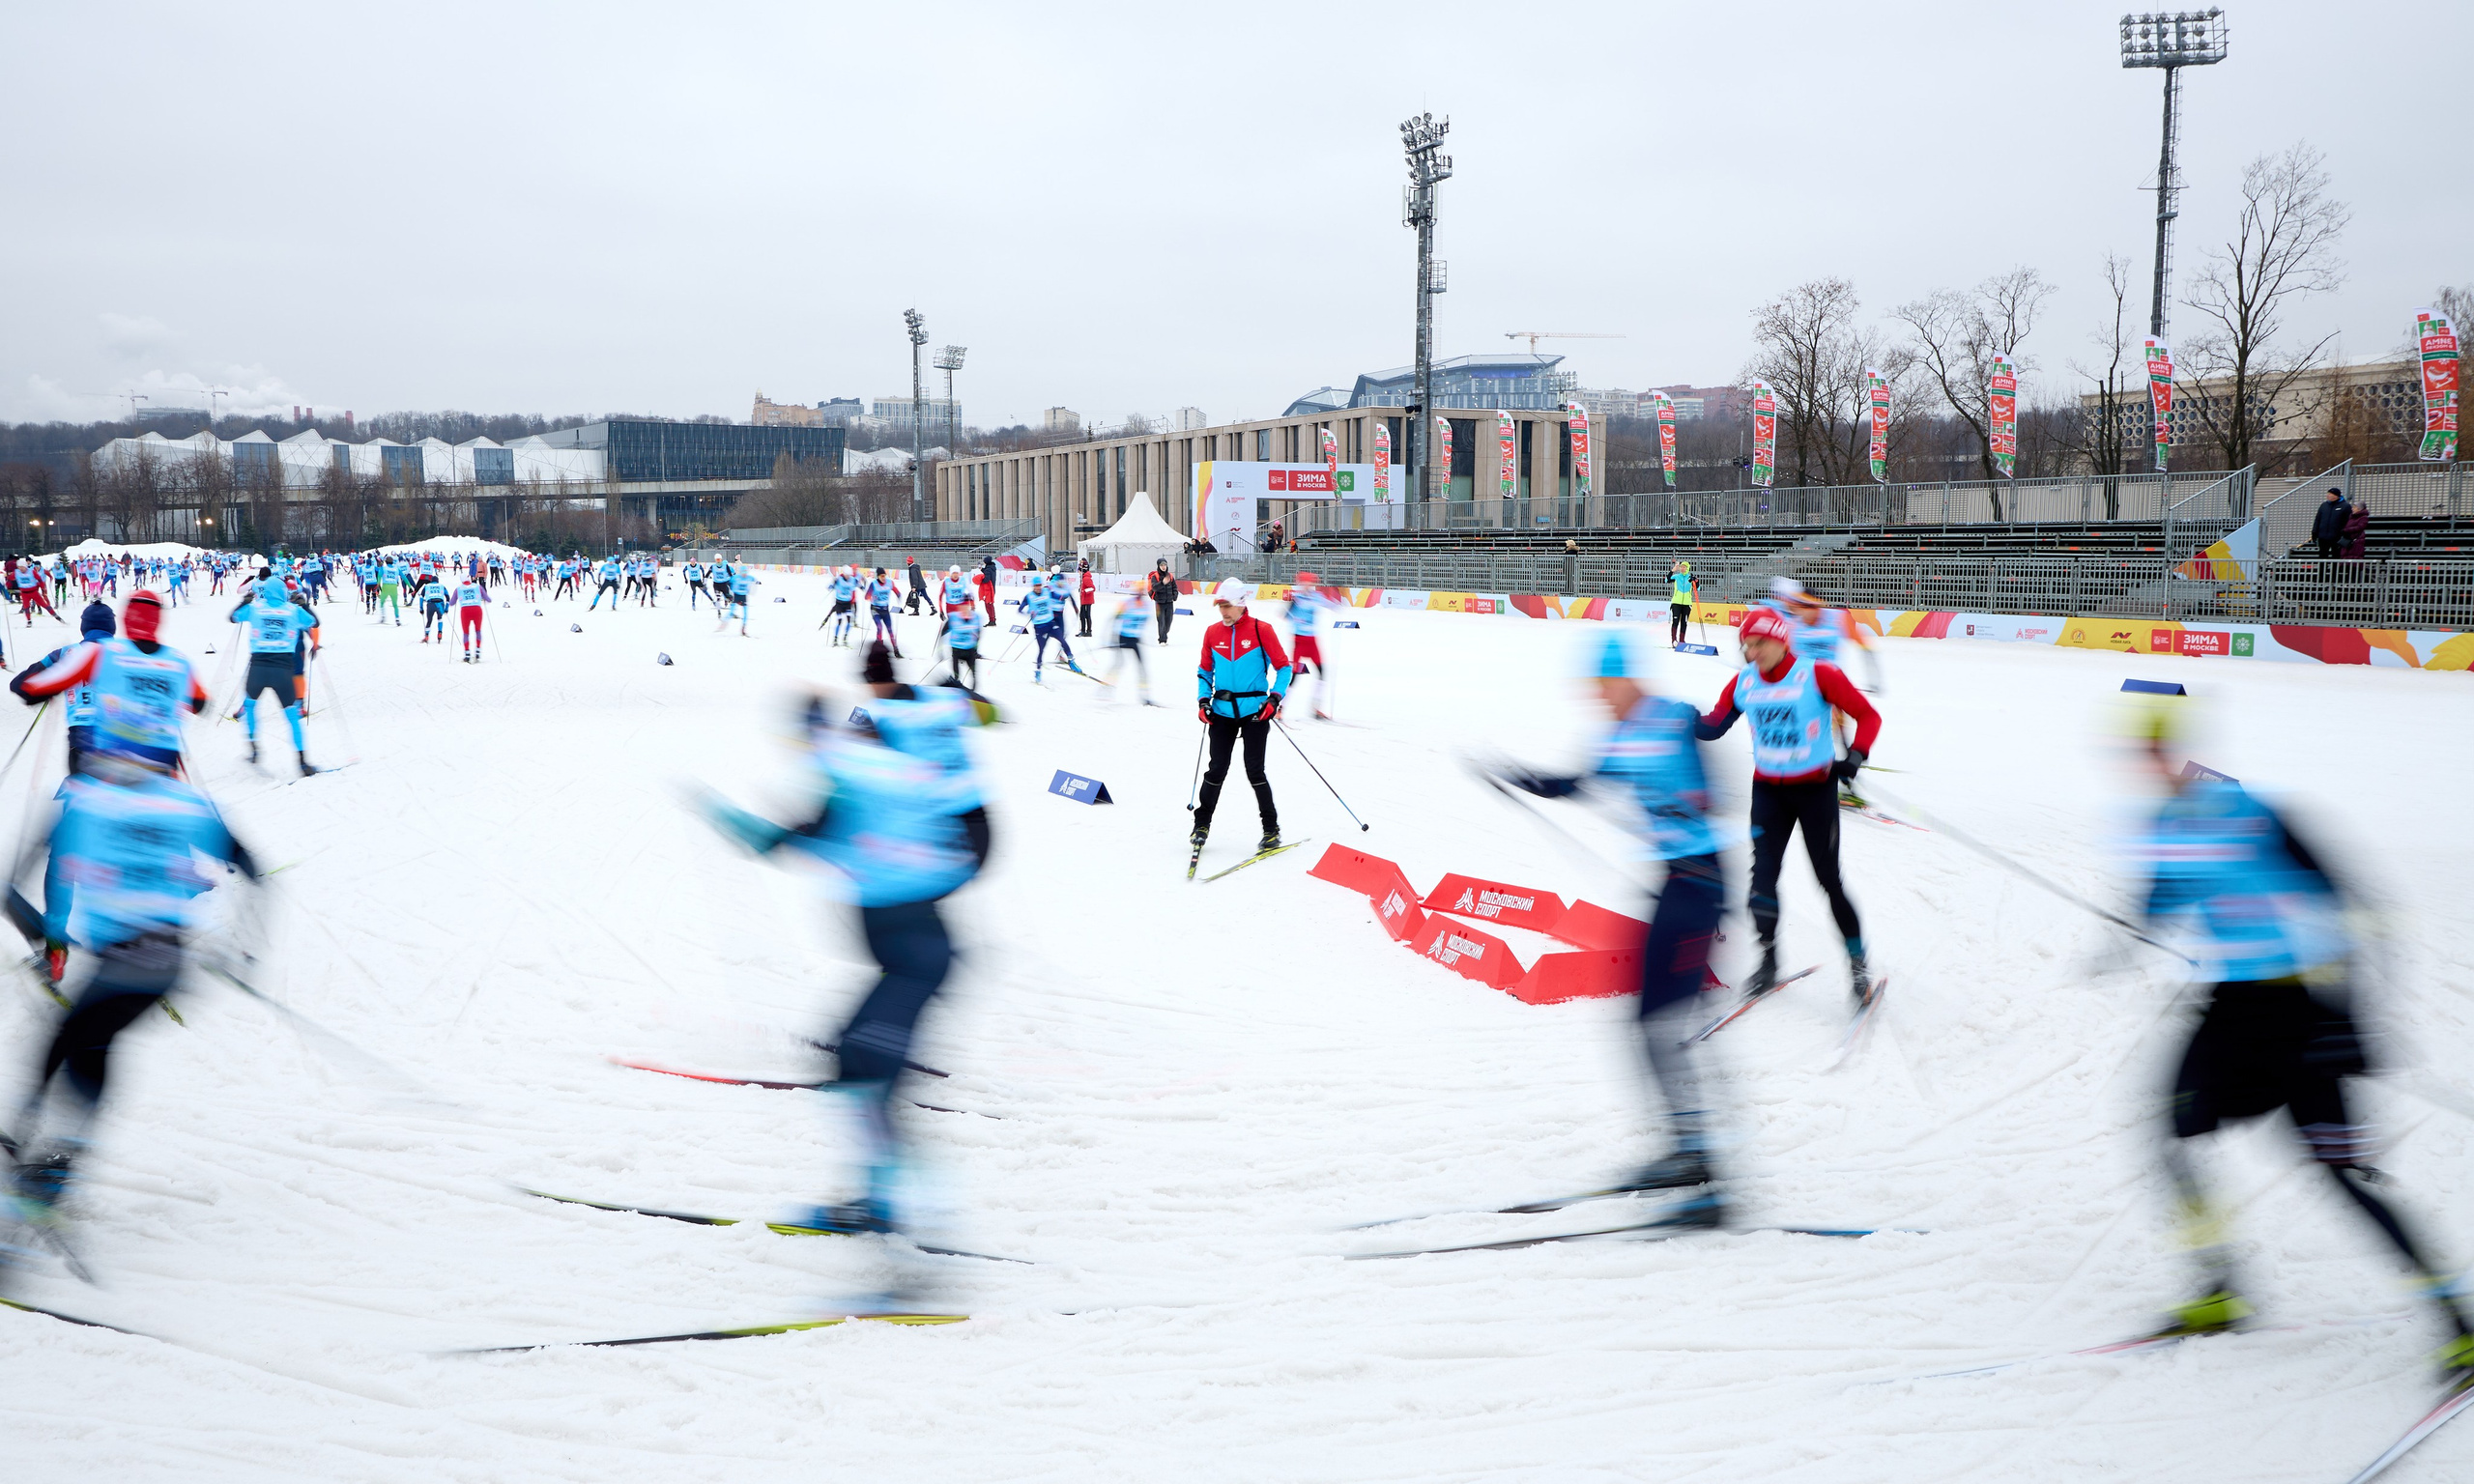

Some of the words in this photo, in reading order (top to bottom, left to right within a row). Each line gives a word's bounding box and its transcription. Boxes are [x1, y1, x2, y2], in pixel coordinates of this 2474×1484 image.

[1297, 473, 1327, 482] ЗИМА
[2184, 634, 2219, 645] ЗИМА
[1479, 889, 1535, 912] МОСКОВСКИЙ
[1474, 904, 1503, 918] СПОРТ
[1440, 947, 1461, 966] СПОРТ
